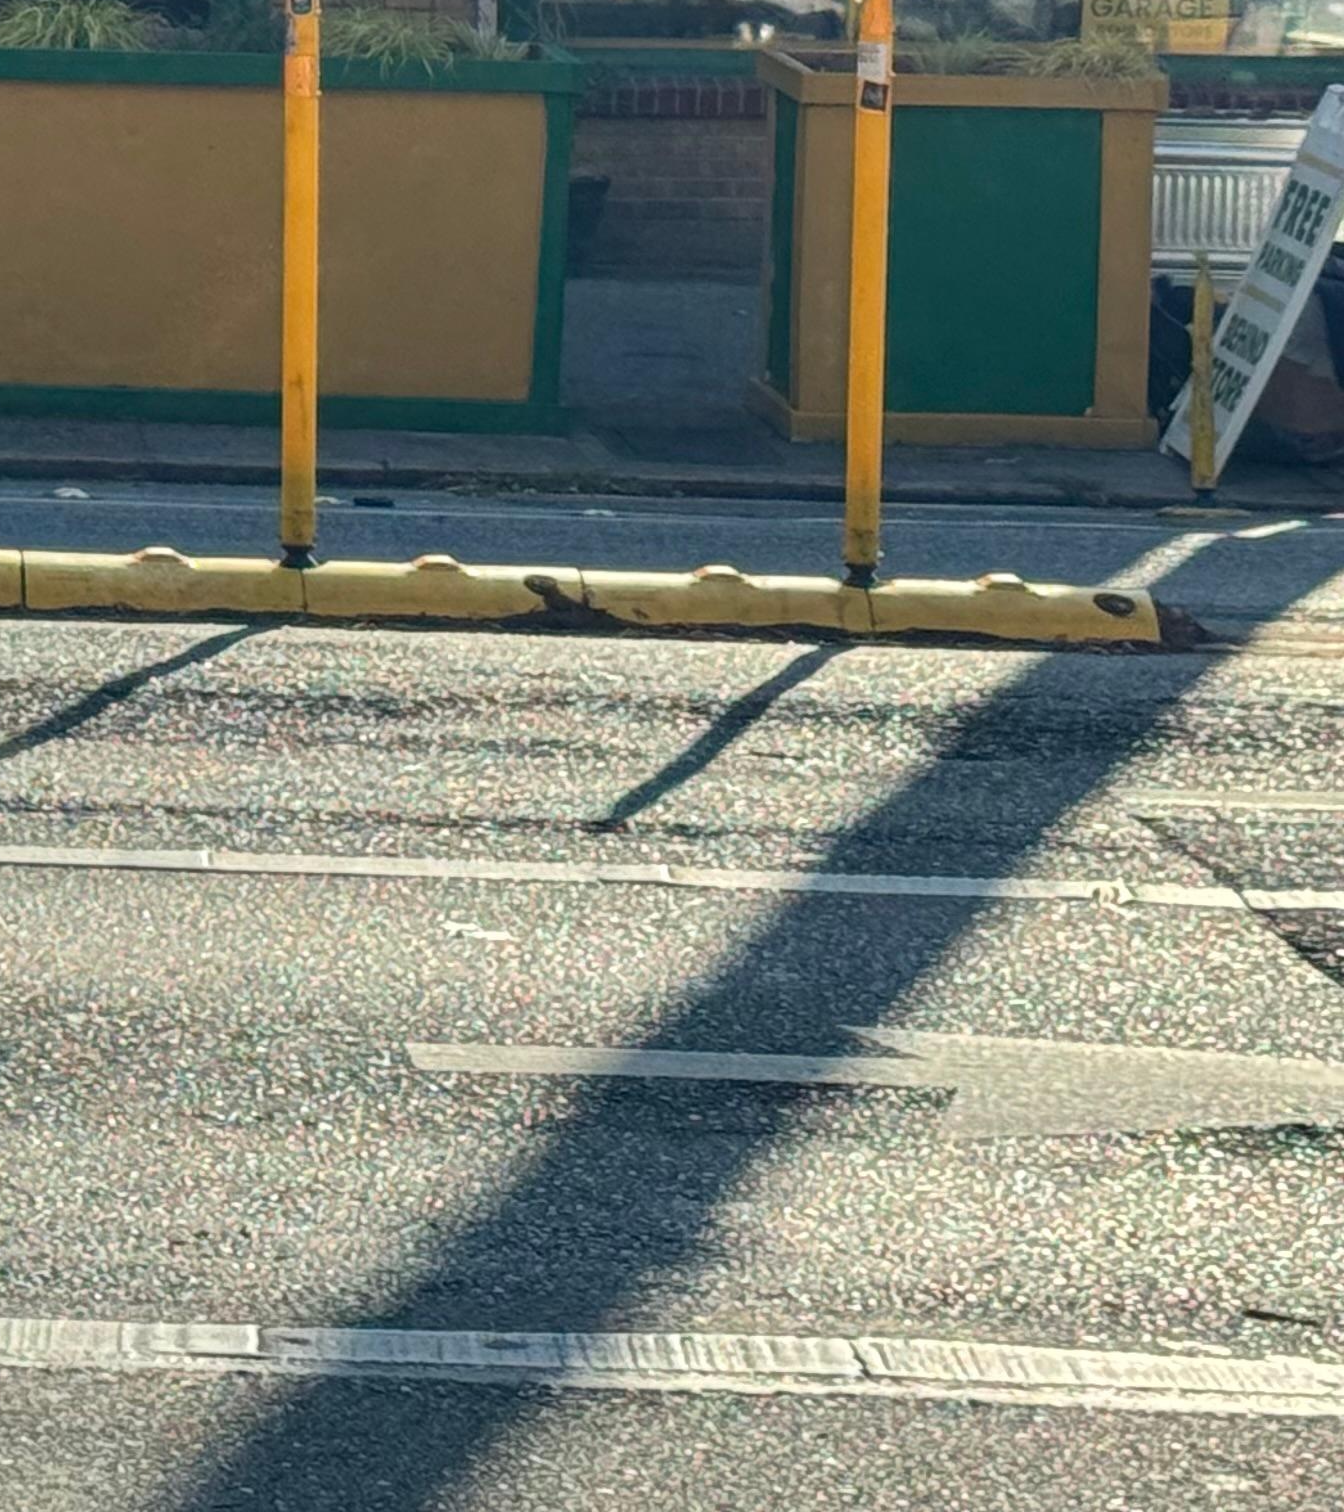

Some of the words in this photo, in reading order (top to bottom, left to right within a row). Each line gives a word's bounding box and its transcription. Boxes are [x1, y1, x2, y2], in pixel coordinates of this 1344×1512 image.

[1273, 179, 1331, 247] FREE
[1219, 313, 1269, 366] BEHIND
[1211, 356, 1252, 414] TORE
